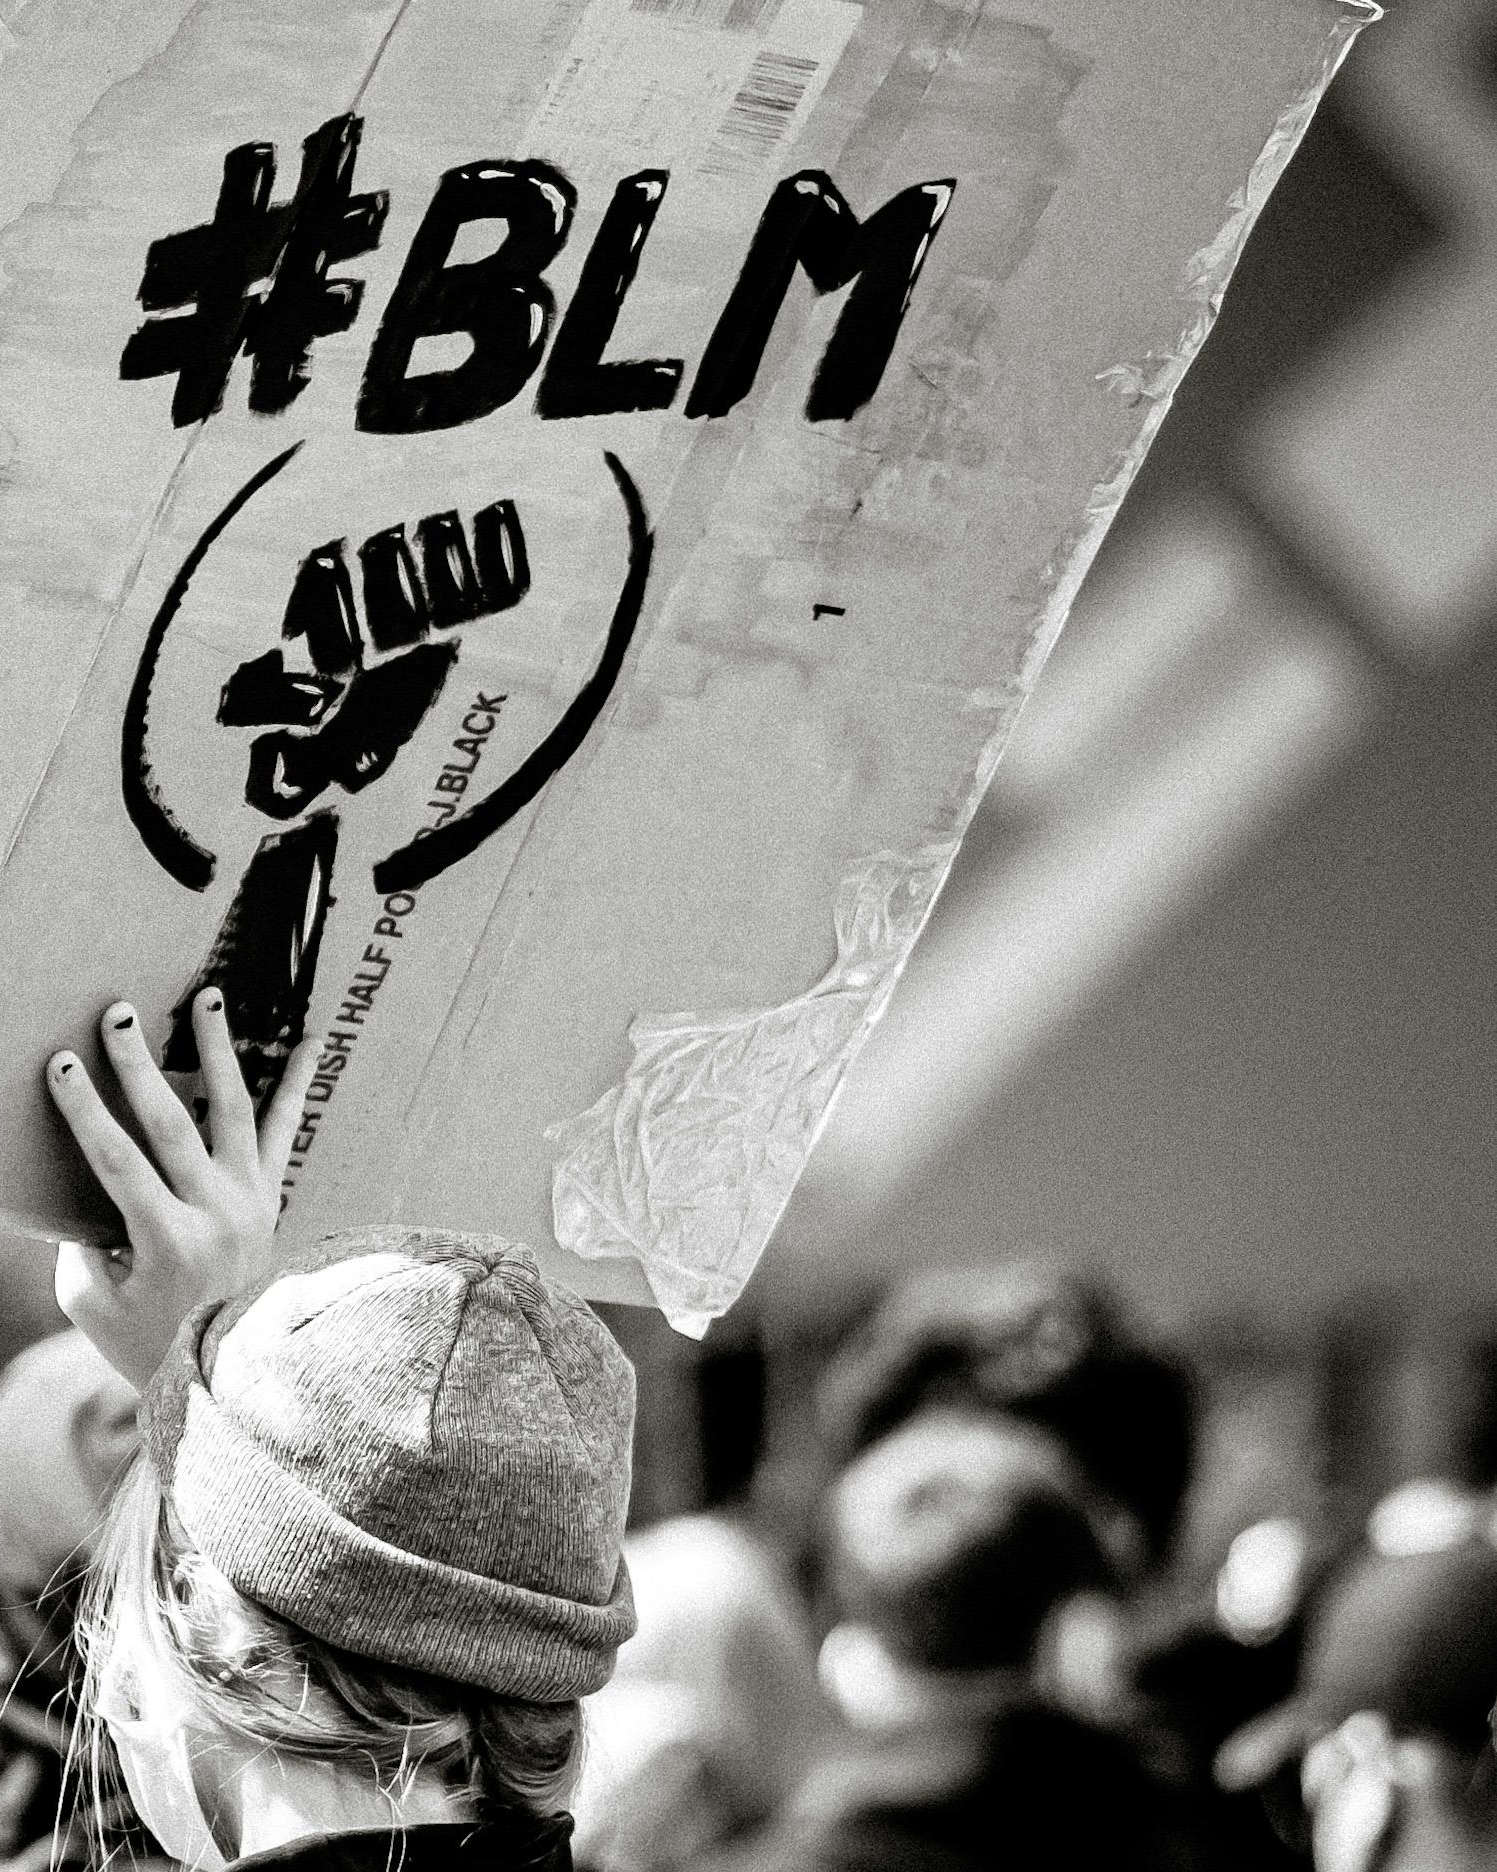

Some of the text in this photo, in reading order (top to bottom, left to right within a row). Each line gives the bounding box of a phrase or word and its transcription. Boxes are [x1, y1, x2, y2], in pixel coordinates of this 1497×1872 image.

[119, 112, 957, 434] #BLM
[305, 1031, 358, 1103] DISH
[336, 943, 392, 1025] HALF
